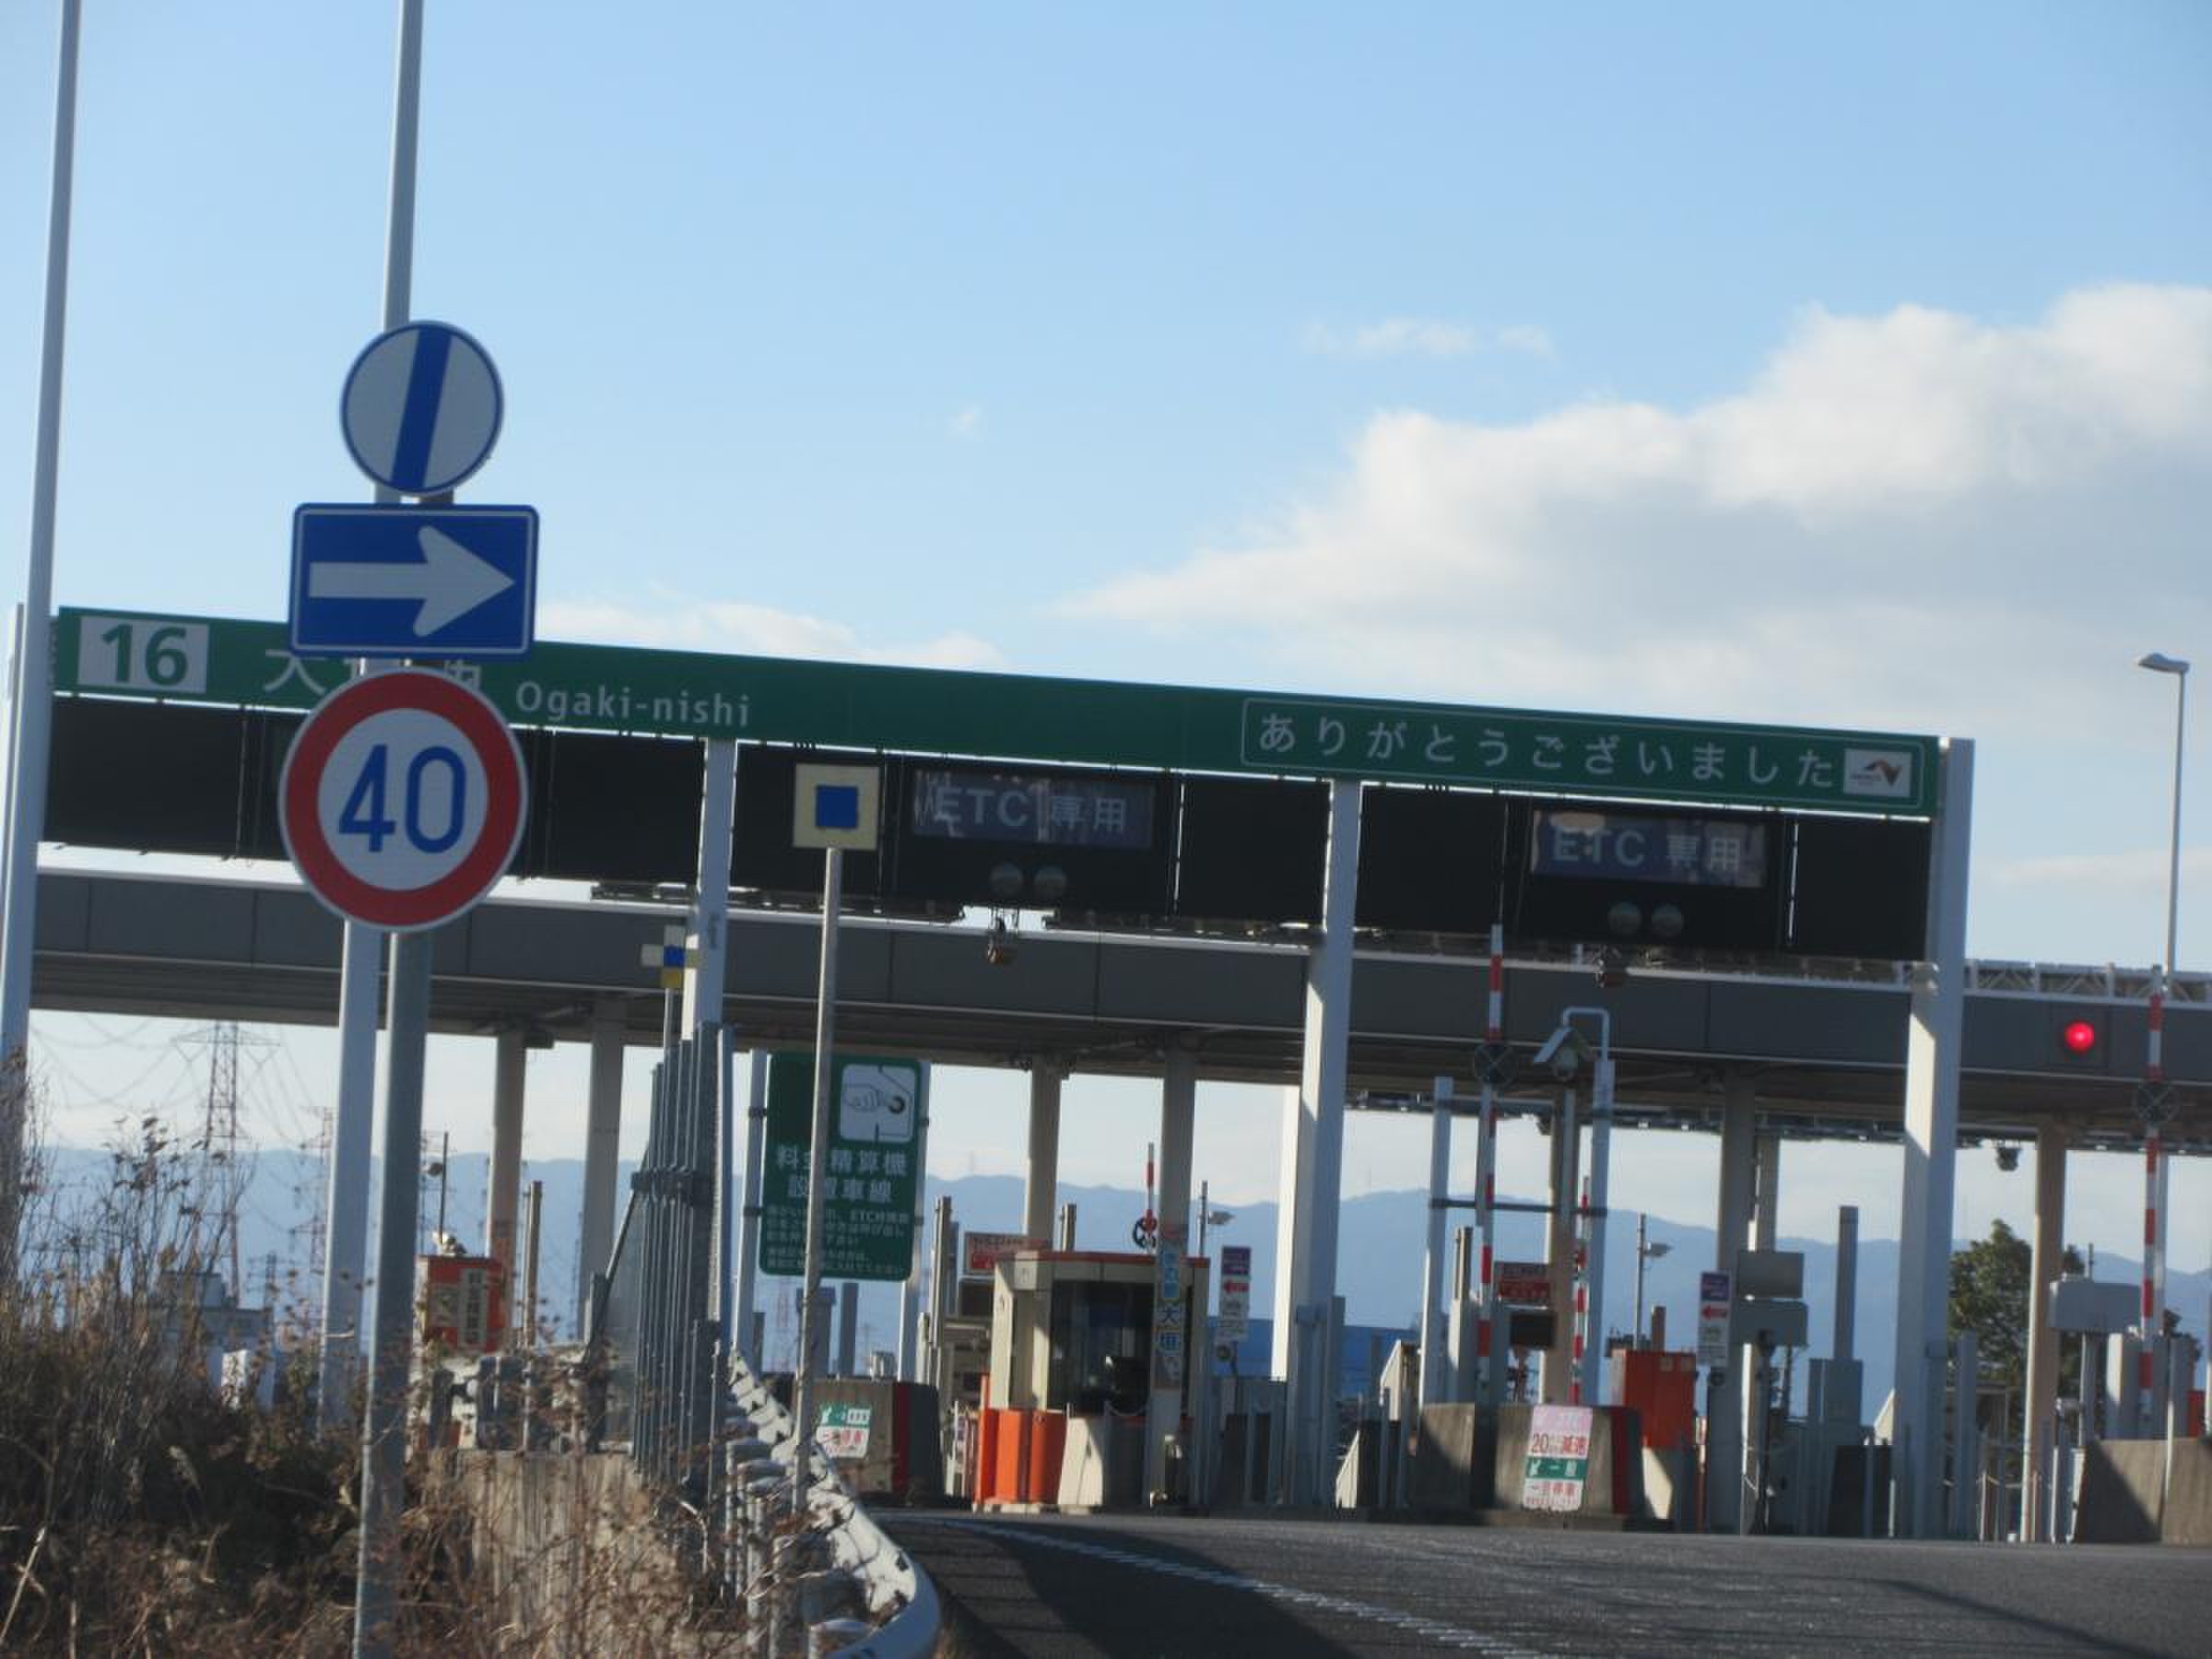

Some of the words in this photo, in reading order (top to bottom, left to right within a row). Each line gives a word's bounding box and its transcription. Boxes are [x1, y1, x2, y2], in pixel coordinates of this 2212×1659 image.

[101, 624, 188, 685] 16
[515, 681, 751, 727] Ogaki-nishi
[1258, 712, 1835, 788] ありがとうございました
[338, 743, 466, 854] 40
[933, 786, 1030, 828] ETC
[1552, 828, 1646, 868] ETC
